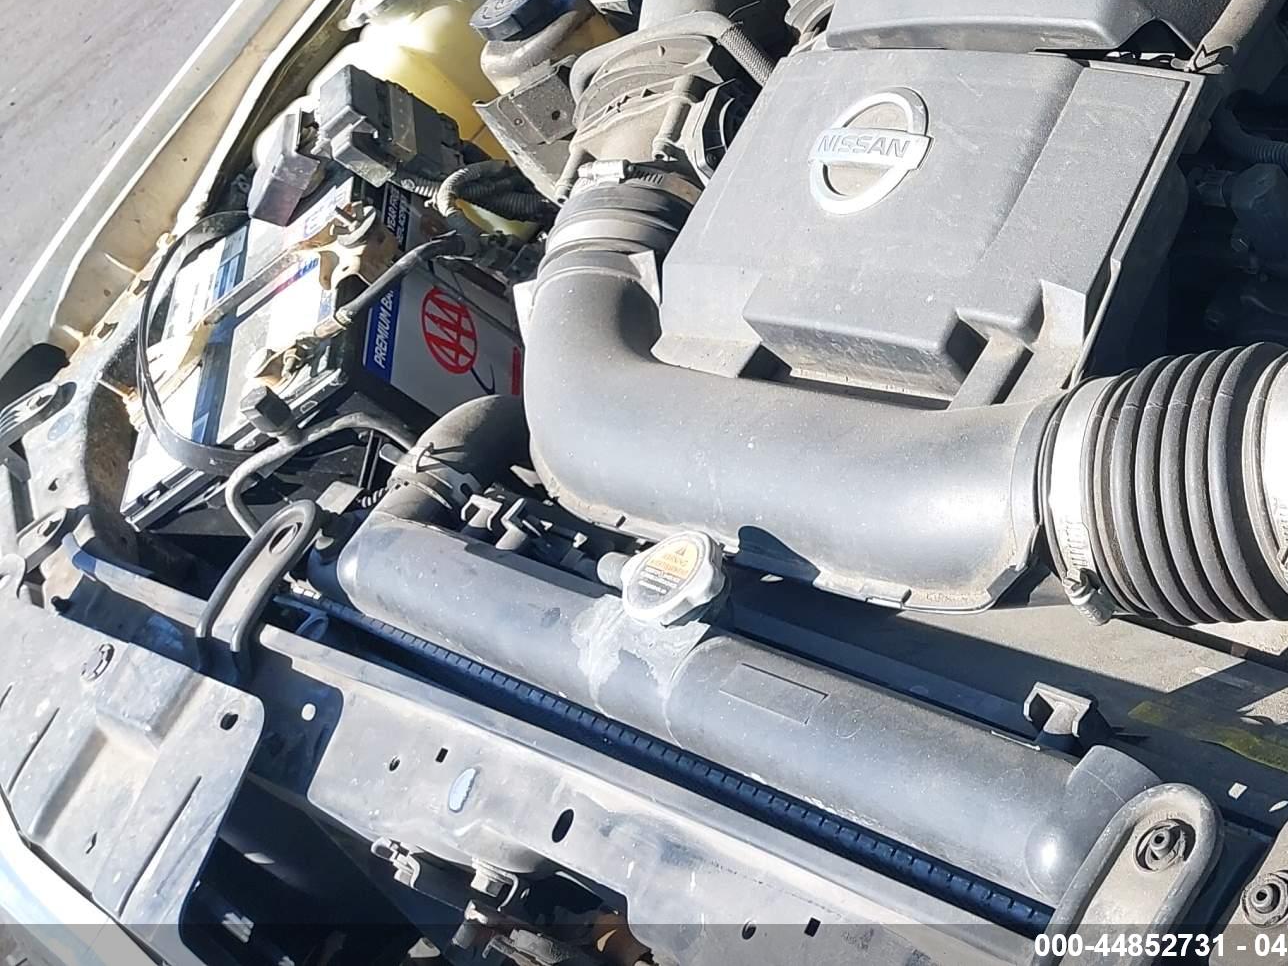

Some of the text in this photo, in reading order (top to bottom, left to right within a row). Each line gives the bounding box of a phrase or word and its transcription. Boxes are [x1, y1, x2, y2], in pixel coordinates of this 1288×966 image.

[817, 134, 911, 158] NISSAN
[373, 306, 392, 370] PREMIUM
[422, 288, 476, 372] AAA
